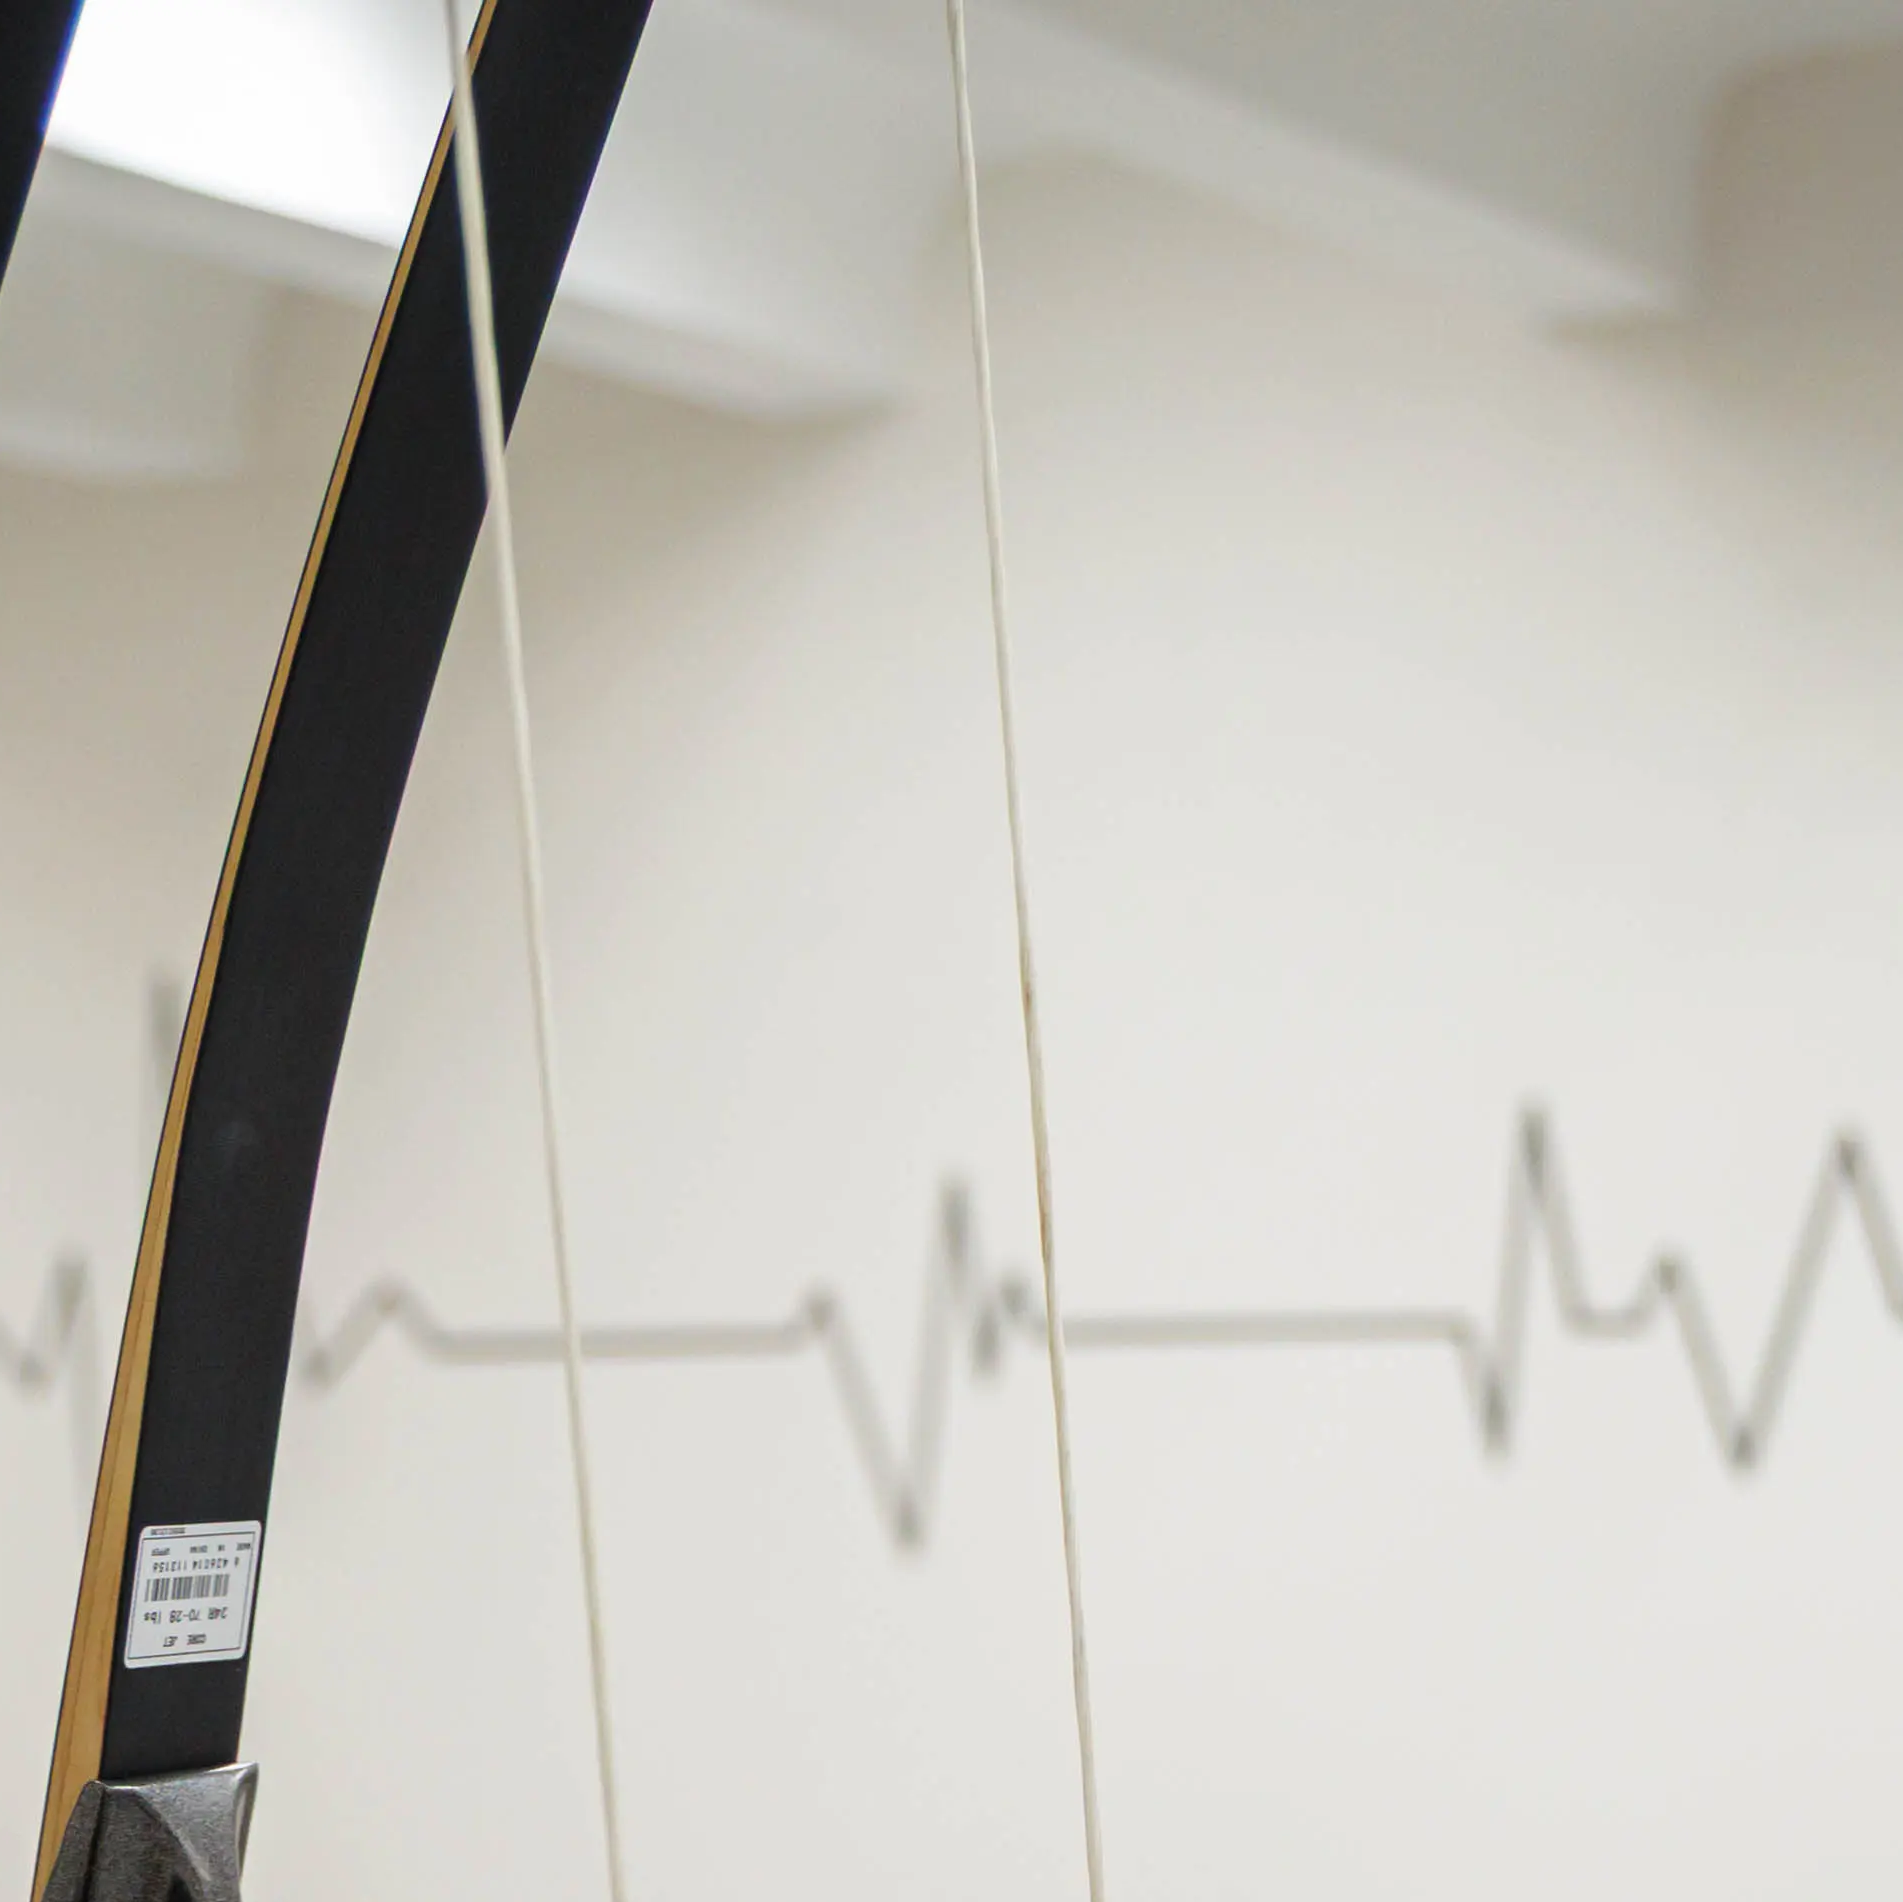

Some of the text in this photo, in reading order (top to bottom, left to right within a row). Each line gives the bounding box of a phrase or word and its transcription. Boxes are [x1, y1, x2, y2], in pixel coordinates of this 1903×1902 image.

[143, 1607, 228, 1624] 24R 70-28 lbs
[163, 1636, 178, 1647] JET
